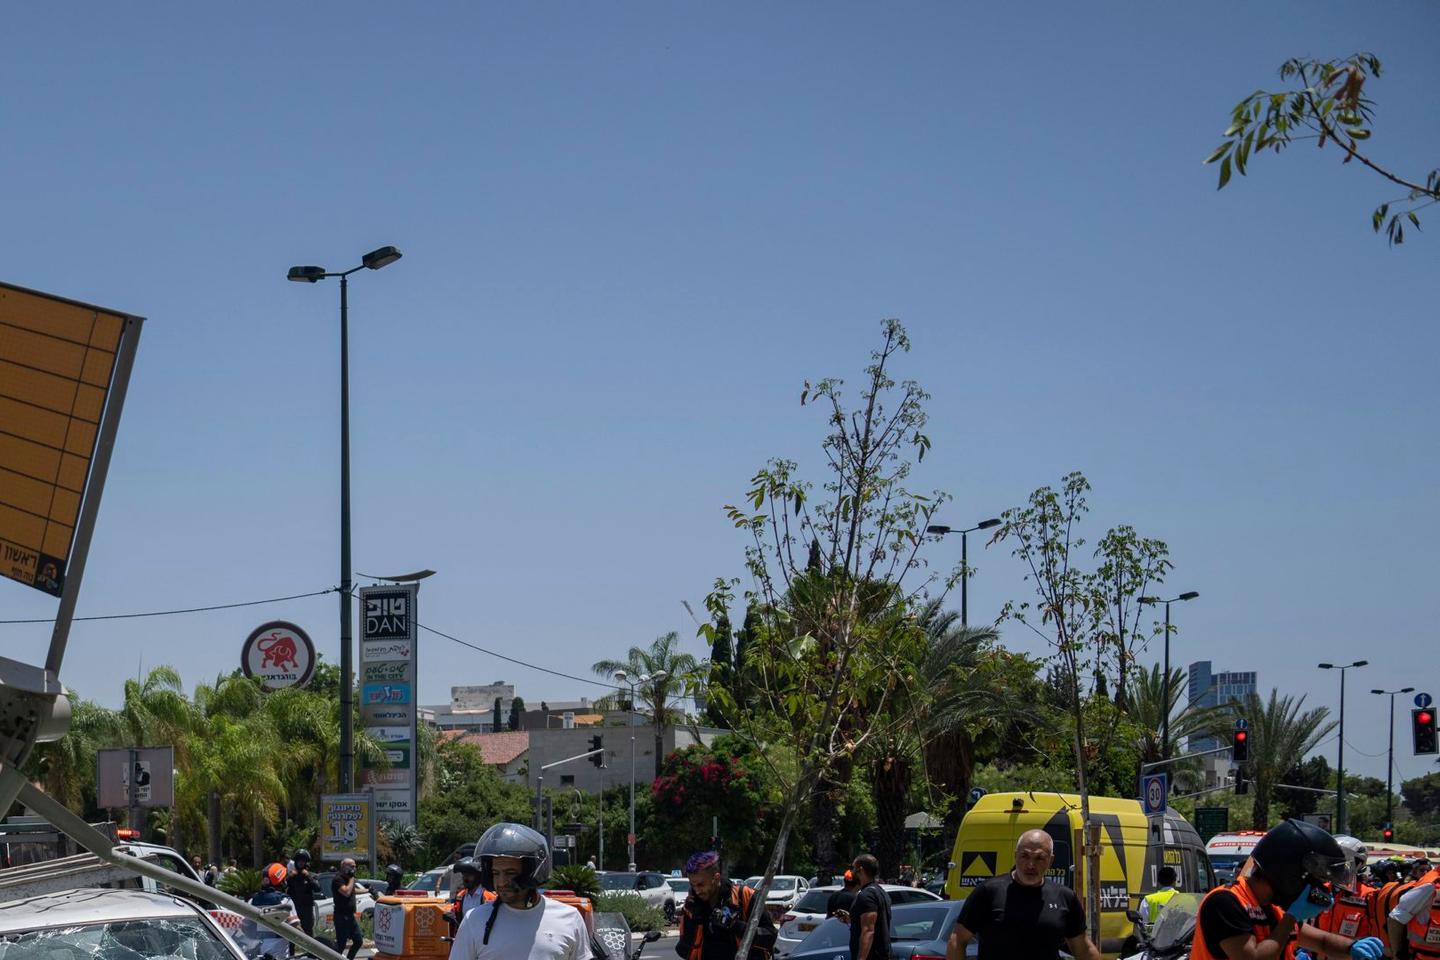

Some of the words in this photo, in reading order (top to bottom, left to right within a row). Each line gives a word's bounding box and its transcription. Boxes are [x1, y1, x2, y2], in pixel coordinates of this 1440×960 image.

[4, 545, 38, 569] ראשון
[366, 598, 406, 616] טופ
[366, 616, 406, 634] DAN
[1149, 789, 1162, 802] 30
[330, 820, 358, 841] 18
